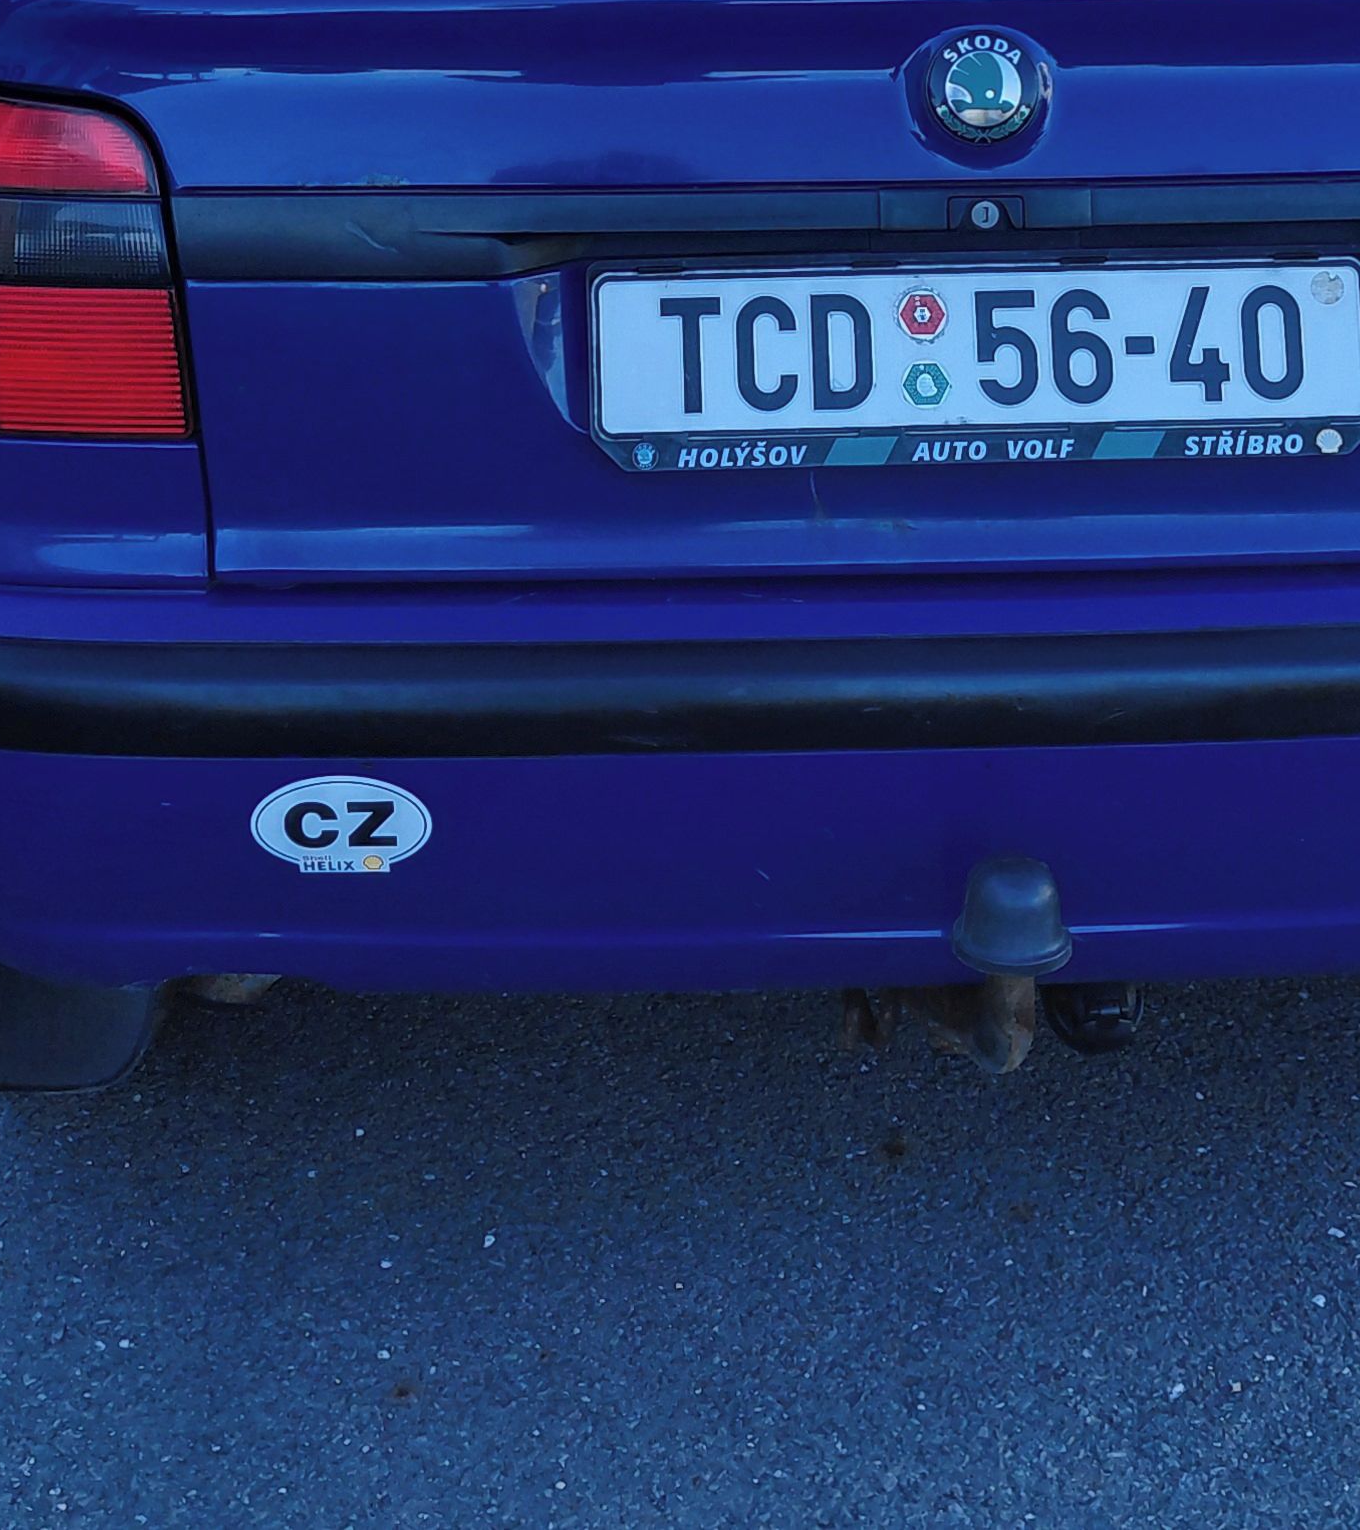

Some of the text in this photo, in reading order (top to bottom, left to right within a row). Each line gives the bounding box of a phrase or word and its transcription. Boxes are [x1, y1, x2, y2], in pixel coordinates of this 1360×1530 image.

[659, 285, 1306, 415] TCD 56-40
[677, 430, 1304, 468] HOLÝŠOV AUTO VOLF STŘÍBRO
[283, 800, 399, 849] CZ
[303, 860, 355, 871] HELIX
